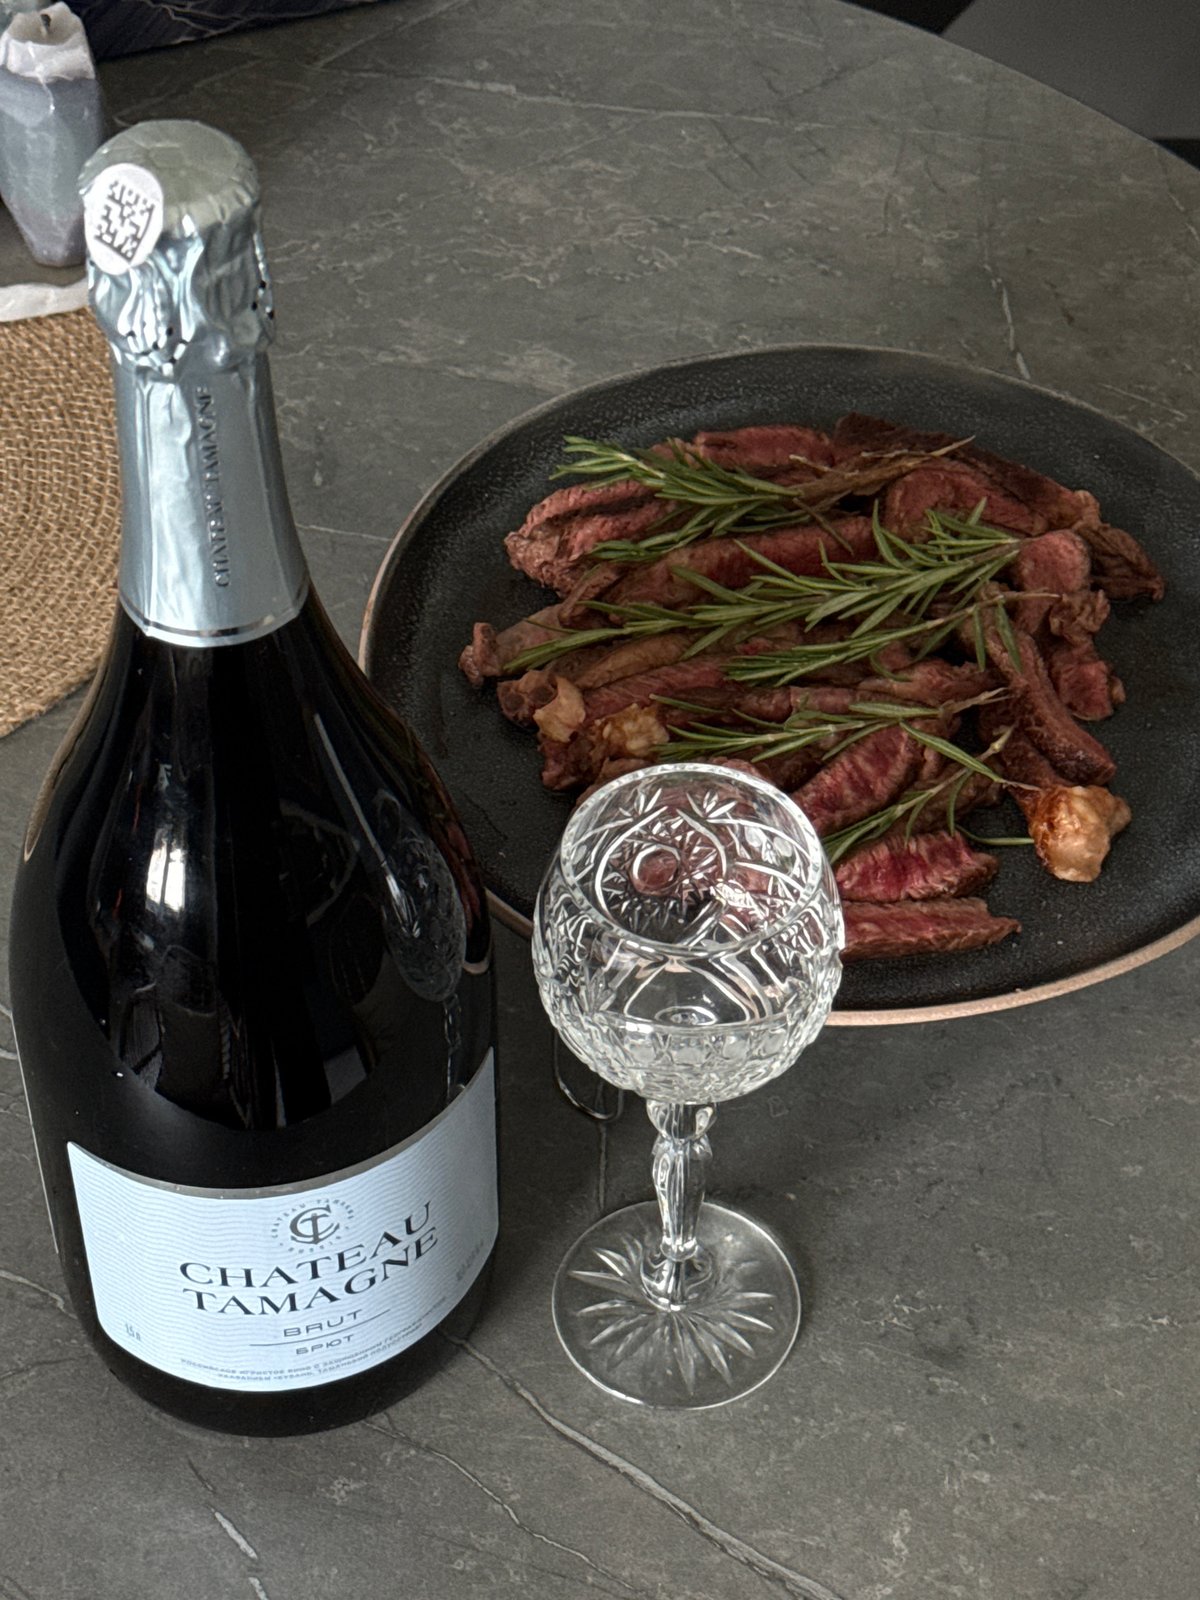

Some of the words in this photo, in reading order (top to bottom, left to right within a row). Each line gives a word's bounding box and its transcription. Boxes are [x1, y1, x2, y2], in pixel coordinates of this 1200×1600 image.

[195, 386, 219, 484] TAMAGNE
[179, 1200, 432, 1289] CHATEAU
[182, 1226, 439, 1317] TAMAGNE
[283, 1309, 363, 1338] BRUT
[295, 1334, 356, 1355] БРЮТ
